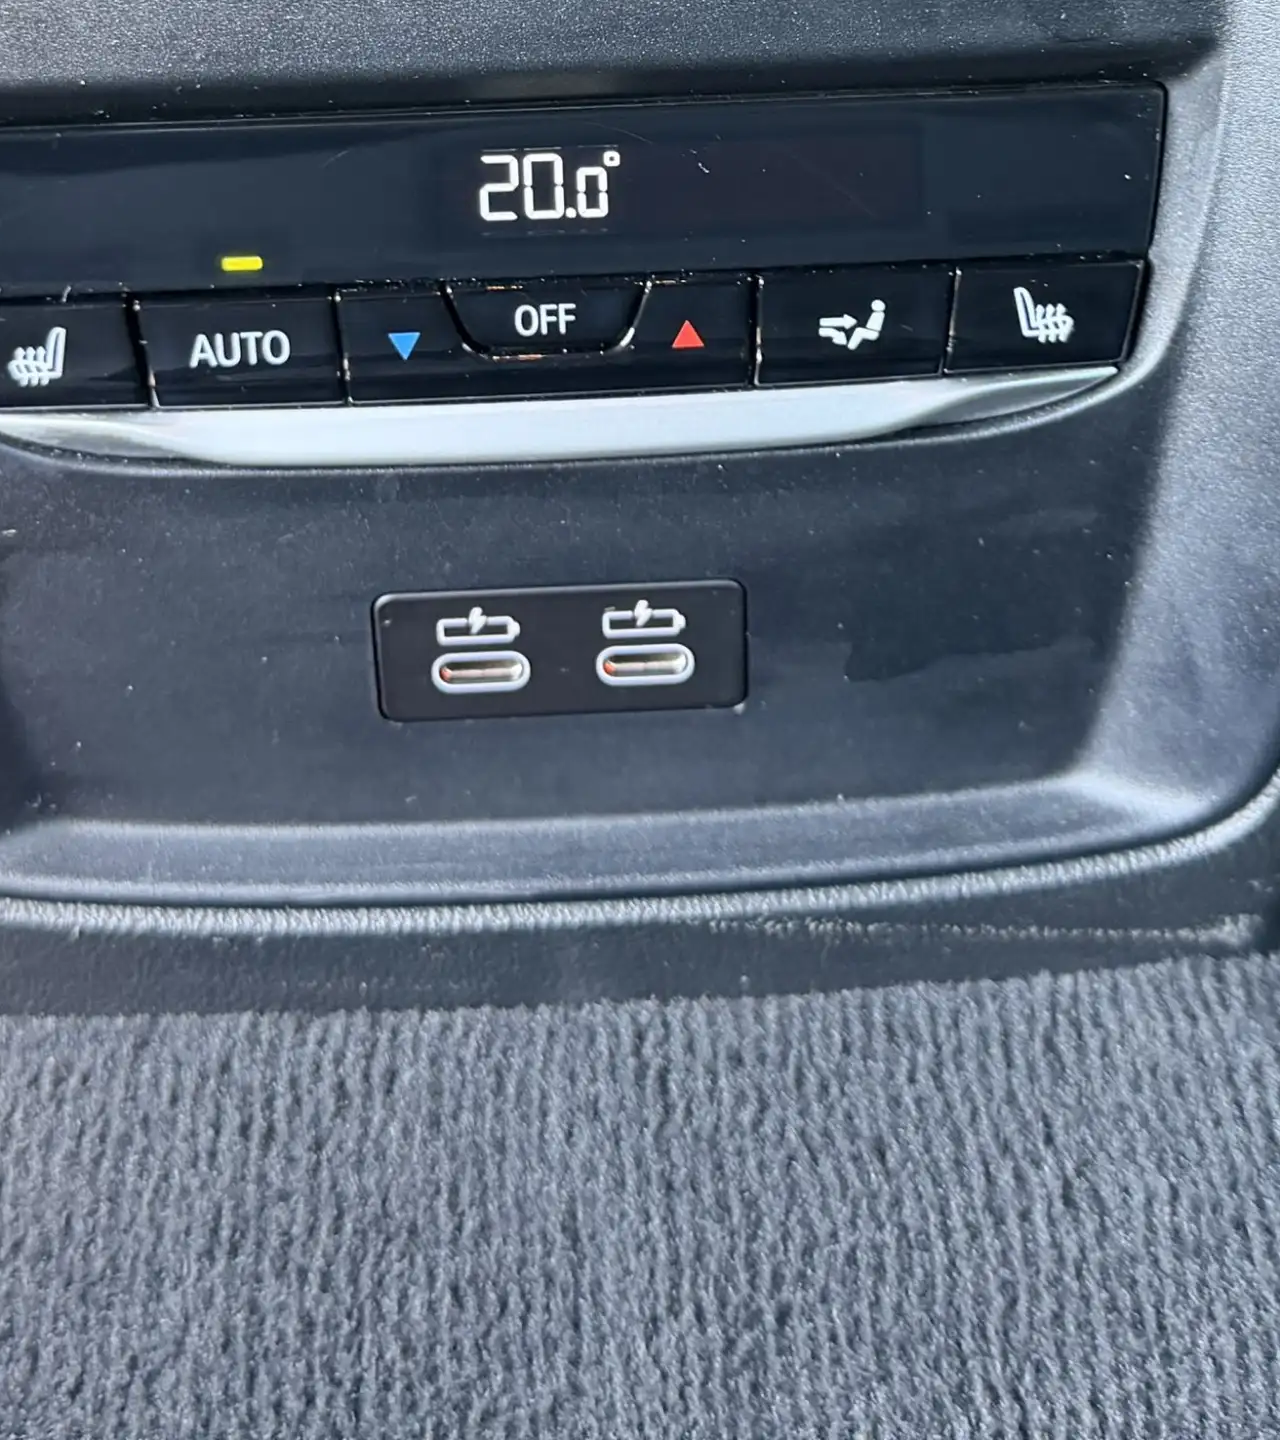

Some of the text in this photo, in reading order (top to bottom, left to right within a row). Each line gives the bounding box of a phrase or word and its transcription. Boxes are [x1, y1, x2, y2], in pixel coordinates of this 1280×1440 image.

[479, 150, 621, 222] 20.0°
[514, 303, 576, 337] OFF
[188, 329, 291, 368] AUTO
